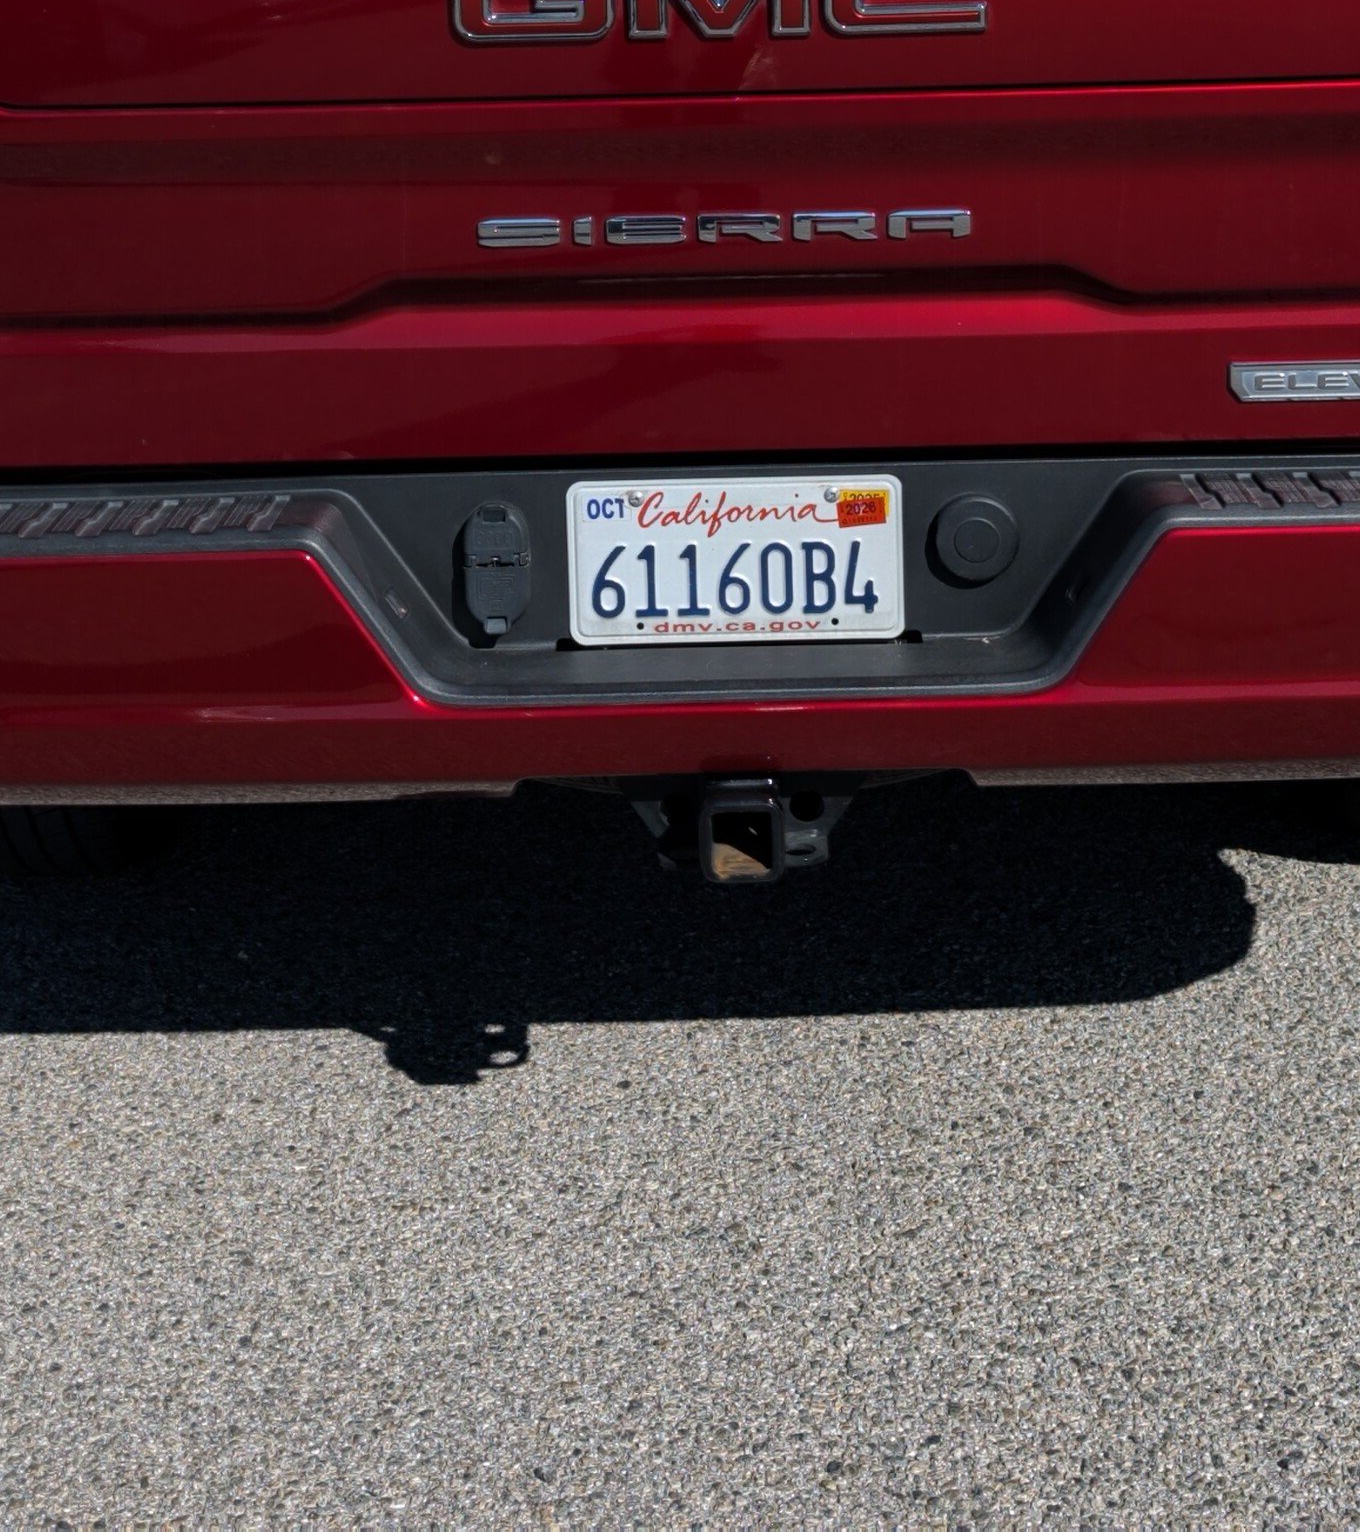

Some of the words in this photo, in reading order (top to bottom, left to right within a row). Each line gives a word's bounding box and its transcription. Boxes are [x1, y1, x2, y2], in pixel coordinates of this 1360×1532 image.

[477, 209, 971, 248] SIERRA
[586, 497, 625, 520] OCT
[637, 490, 838, 537] California
[591, 539, 879, 619] 61160B4
[654, 619, 822, 634] dmv.ca.gov
